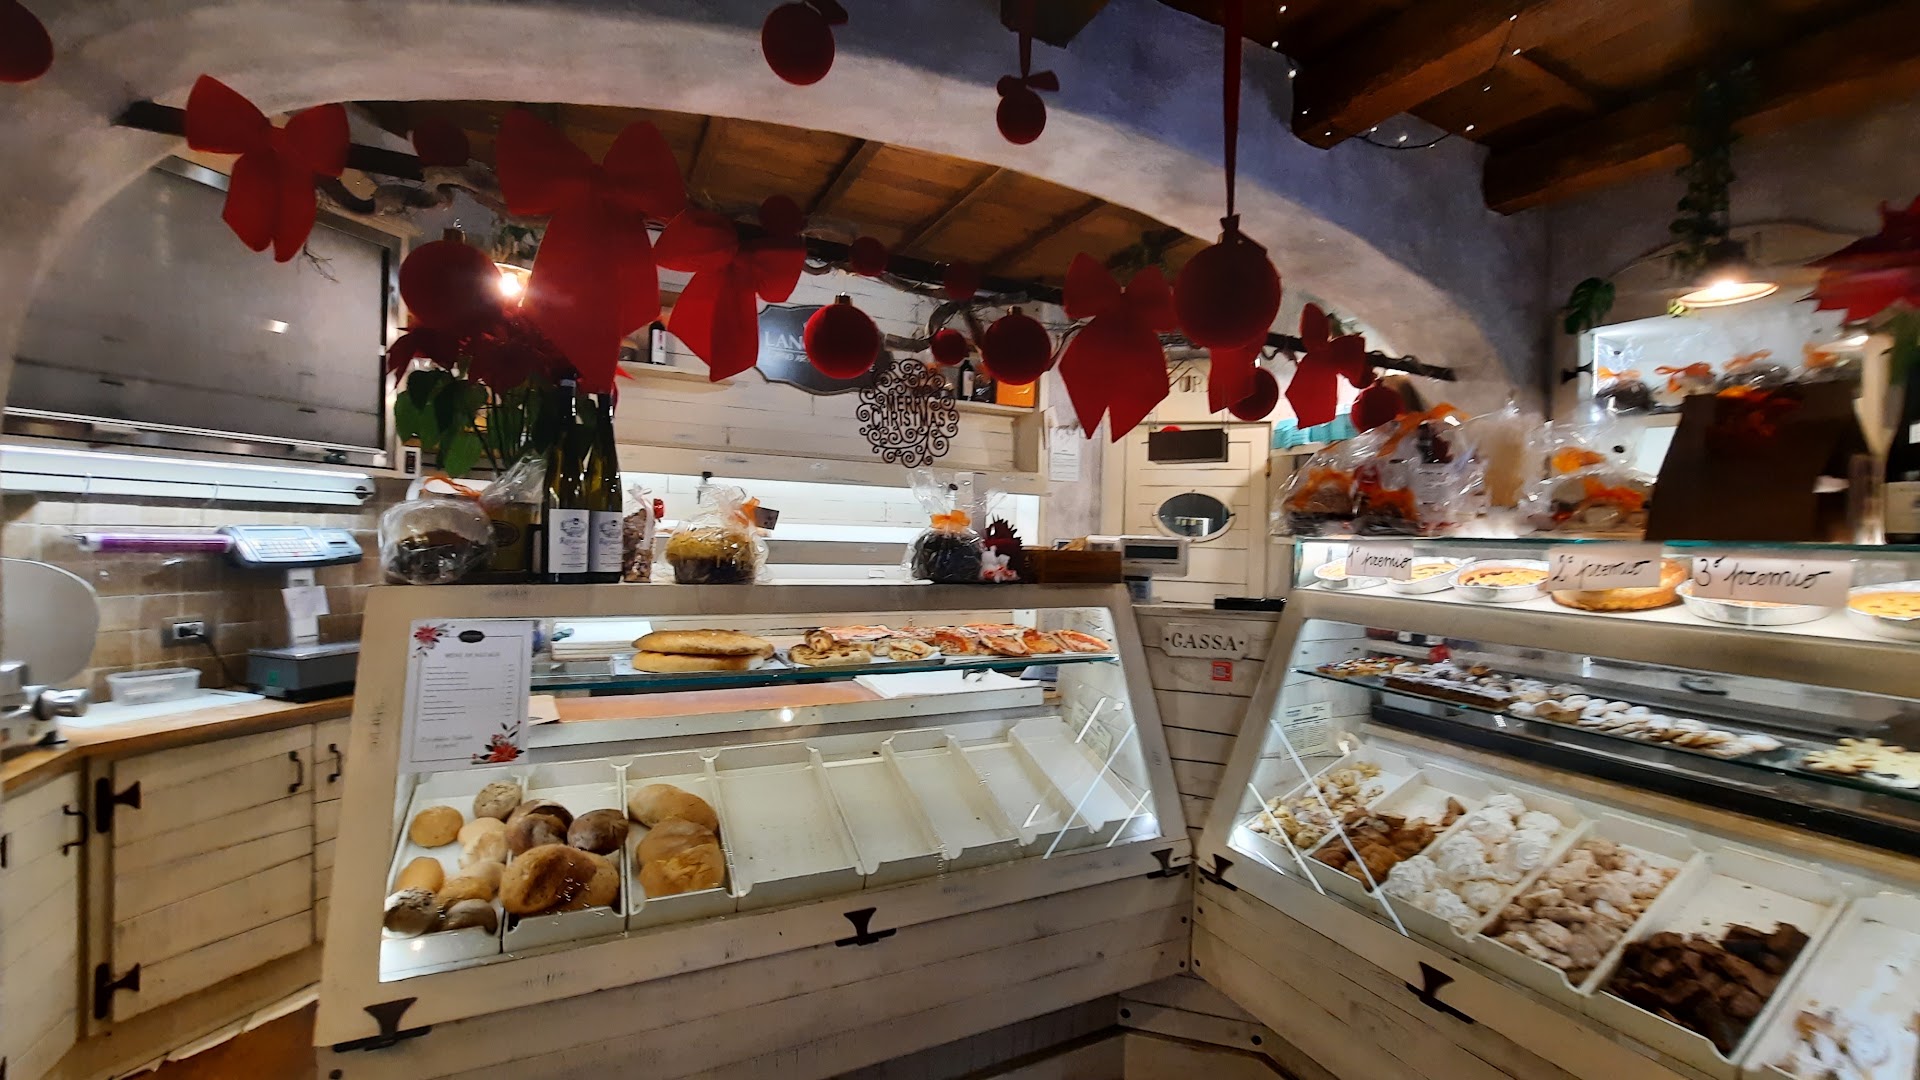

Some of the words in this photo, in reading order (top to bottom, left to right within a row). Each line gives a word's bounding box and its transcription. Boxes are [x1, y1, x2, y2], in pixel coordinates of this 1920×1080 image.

[764, 331, 804, 350] LAN
[885, 395, 929, 412] MERRY
[872, 409, 946, 427] CHRISTMAS
[1361, 549, 1412, 572] premio
[1577, 560, 1652, 588] premio
[1723, 564, 1833, 595] premio
